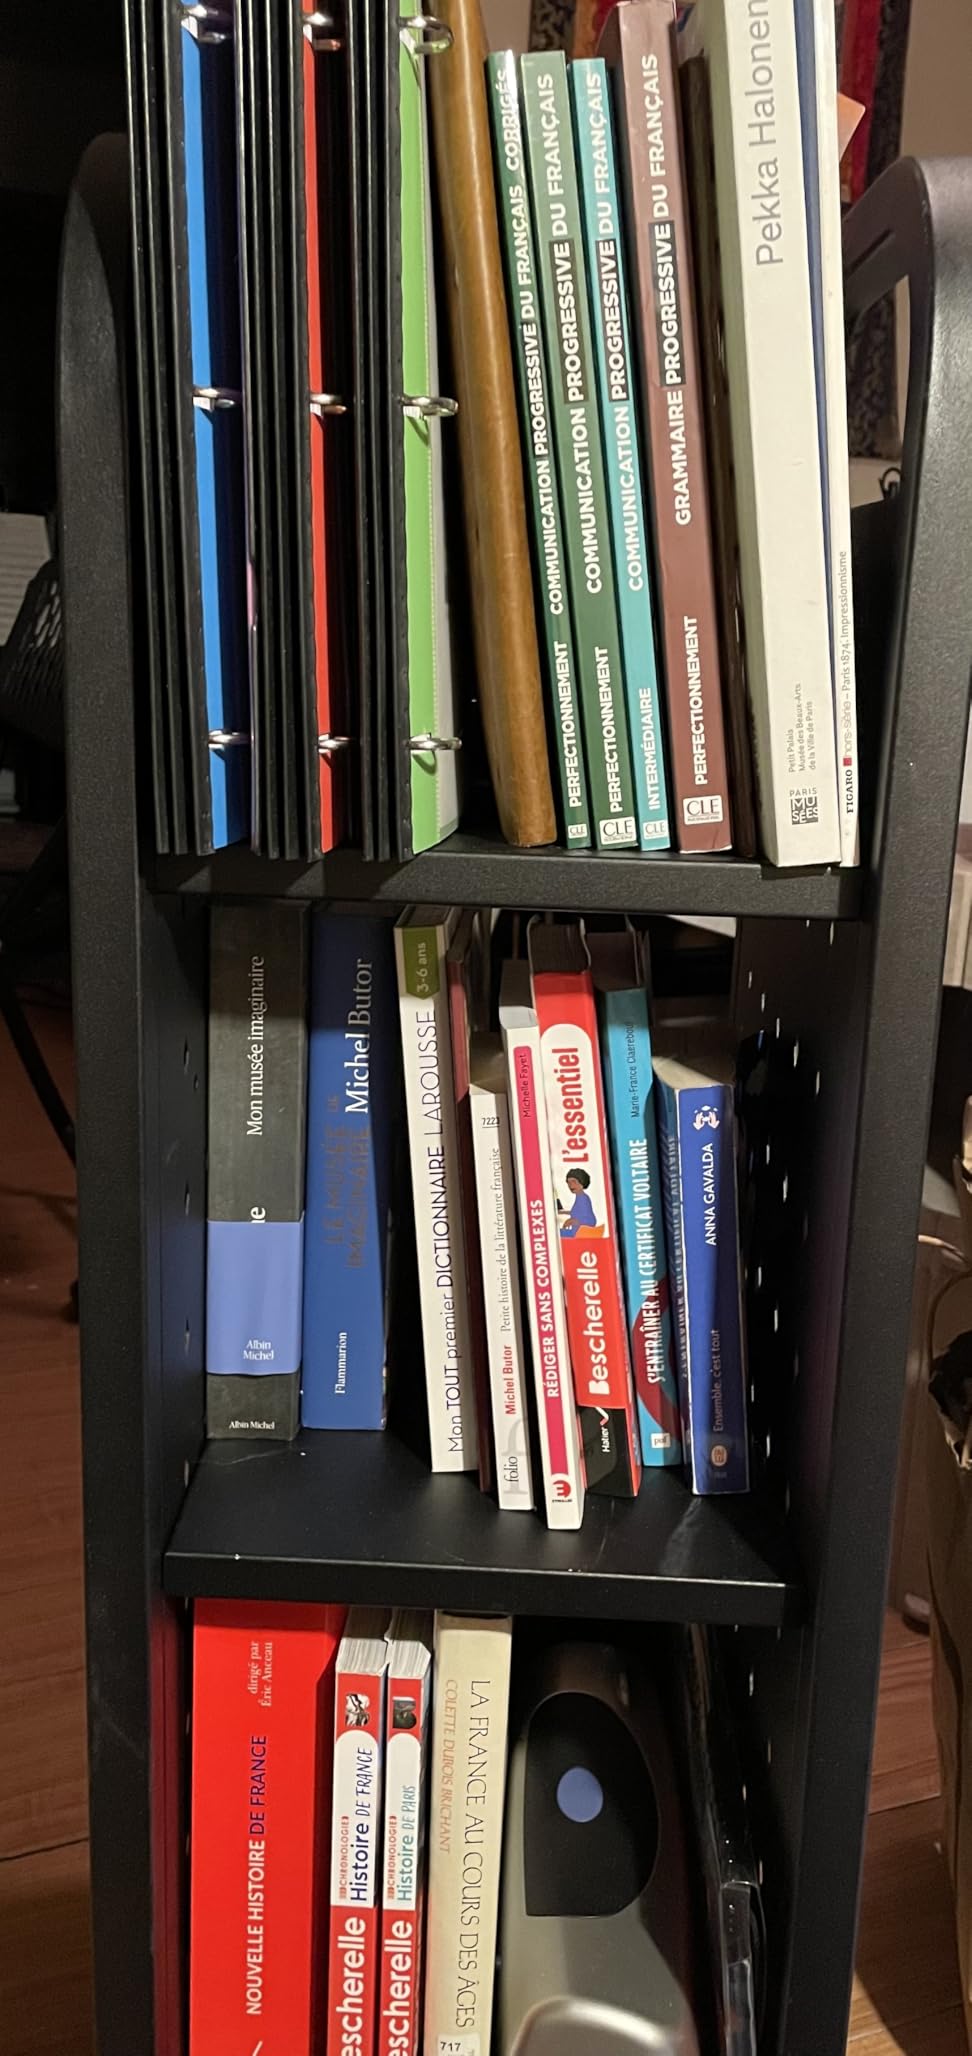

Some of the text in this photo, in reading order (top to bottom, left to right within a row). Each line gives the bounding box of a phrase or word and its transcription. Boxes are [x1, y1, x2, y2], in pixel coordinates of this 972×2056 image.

[495, 69, 520, 171] CORRIGÉS
[744, 0, 783, 265] Pekka Halonen
[642, 53, 691, 525] GRAMMAIRE PROGRESSIVE DU FRANÇAIS
[537, 73, 602, 594] COMMUNICATION PROGRESSIVE DU FRANÇAIS
[587, 71, 643, 591] COMMUNICATION PROGRESSIVE DU FRANÇAIS
[509, 184, 563, 615] COMMUNICATION PROGRESSIVE DU FRANÇAIS
[837, 551, 850, 638] Impressionnisme
[684, 616, 708, 786] PERFECTIONNEMENT
[841, 666, 851, 691] Paris
[553, 640, 582, 807] PERFECTIONNEMENT
[595, 646, 623, 813] PERFECTIONNEMENT
[639, 687, 661, 811] INTERMÉDIAIRE
[785, 729, 796, 773] Petit Palais
[793, 683, 806, 771] Musée des Beaux-Arts
[805, 702, 816, 770] de la Ville de Paris
[841, 701, 852, 757] hors-série
[686, 798, 720, 816] CLE
[789, 787, 818, 797] PARIS
[845, 769, 854, 814] FIGARO
[569, 824, 586, 836] CLE
[603, 820, 633, 836] CLE
[645, 822, 666, 836] CLE
[416, 943, 429, 993] 3-6 ans
[246, 956, 268, 1136] Mon musée imaginaire
[344, 958, 373, 1114] Michel Butor
[518, 1054, 531, 1118] Michelle Fayet
[552, 1047, 589, 1163] L'essentiel
[628, 1066, 641, 1118] Marie-France
[702, 1143, 717, 1246] ANNA GAVALDA
[416, 1011, 464, 1453] Mon TOUT premier DICTIONNAIRE LAROUSSE
[490, 1148, 511, 1332] Petite histoire de la littérature française
[629, 1138, 666, 1384] S'ENTRAÎNER AU CERTIFICAT VOLTAIRE
[530, 1199, 560, 1397] RÉDIGER SANS COMPLEXES
[577, 1251, 610, 1395] Bescherelle
[243, 1350, 275, 1361] Michel
[246, 1340, 271, 1350] Albin
[333, 1332, 348, 1394] Flammarion
[709, 1329, 720, 1352] tout
[709, 1355, 721, 1377] c'est
[502, 1345, 516, 1415] Michel Butor
[229, 1421, 275, 1430] Albin Michel
[600, 1427, 611, 1452] Hatier
[503, 1456, 519, 1482] folio
[247, 1640, 261, 1694] dirigé par
[257, 1642, 272, 1707] Éric Anceau
[470, 1680, 490, 1708] LA
[439, 1679, 458, 1854] COLETTE DUBOIS BRICHANT
[466, 1717, 489, 1806] FRANCE
[339, 1820, 349, 1887] CHRONOLOGIE
[349, 1747, 374, 1902] Histoire DE FRANCE
[387, 1820, 397, 1888] CHRONOLOGIE
[396, 1785, 416, 1902] Histoire DE PARIS
[464, 1813, 484, 1844] AU
[245, 1736, 267, 2015] NOUVELLE HISTOIRE DE FRANCE
[460, 1852, 483, 1926] COURS
[458, 1933, 479, 1970] DES
[336, 1917, 366, 2056] escherelle
[440, 2041, 461, 2052] 717
